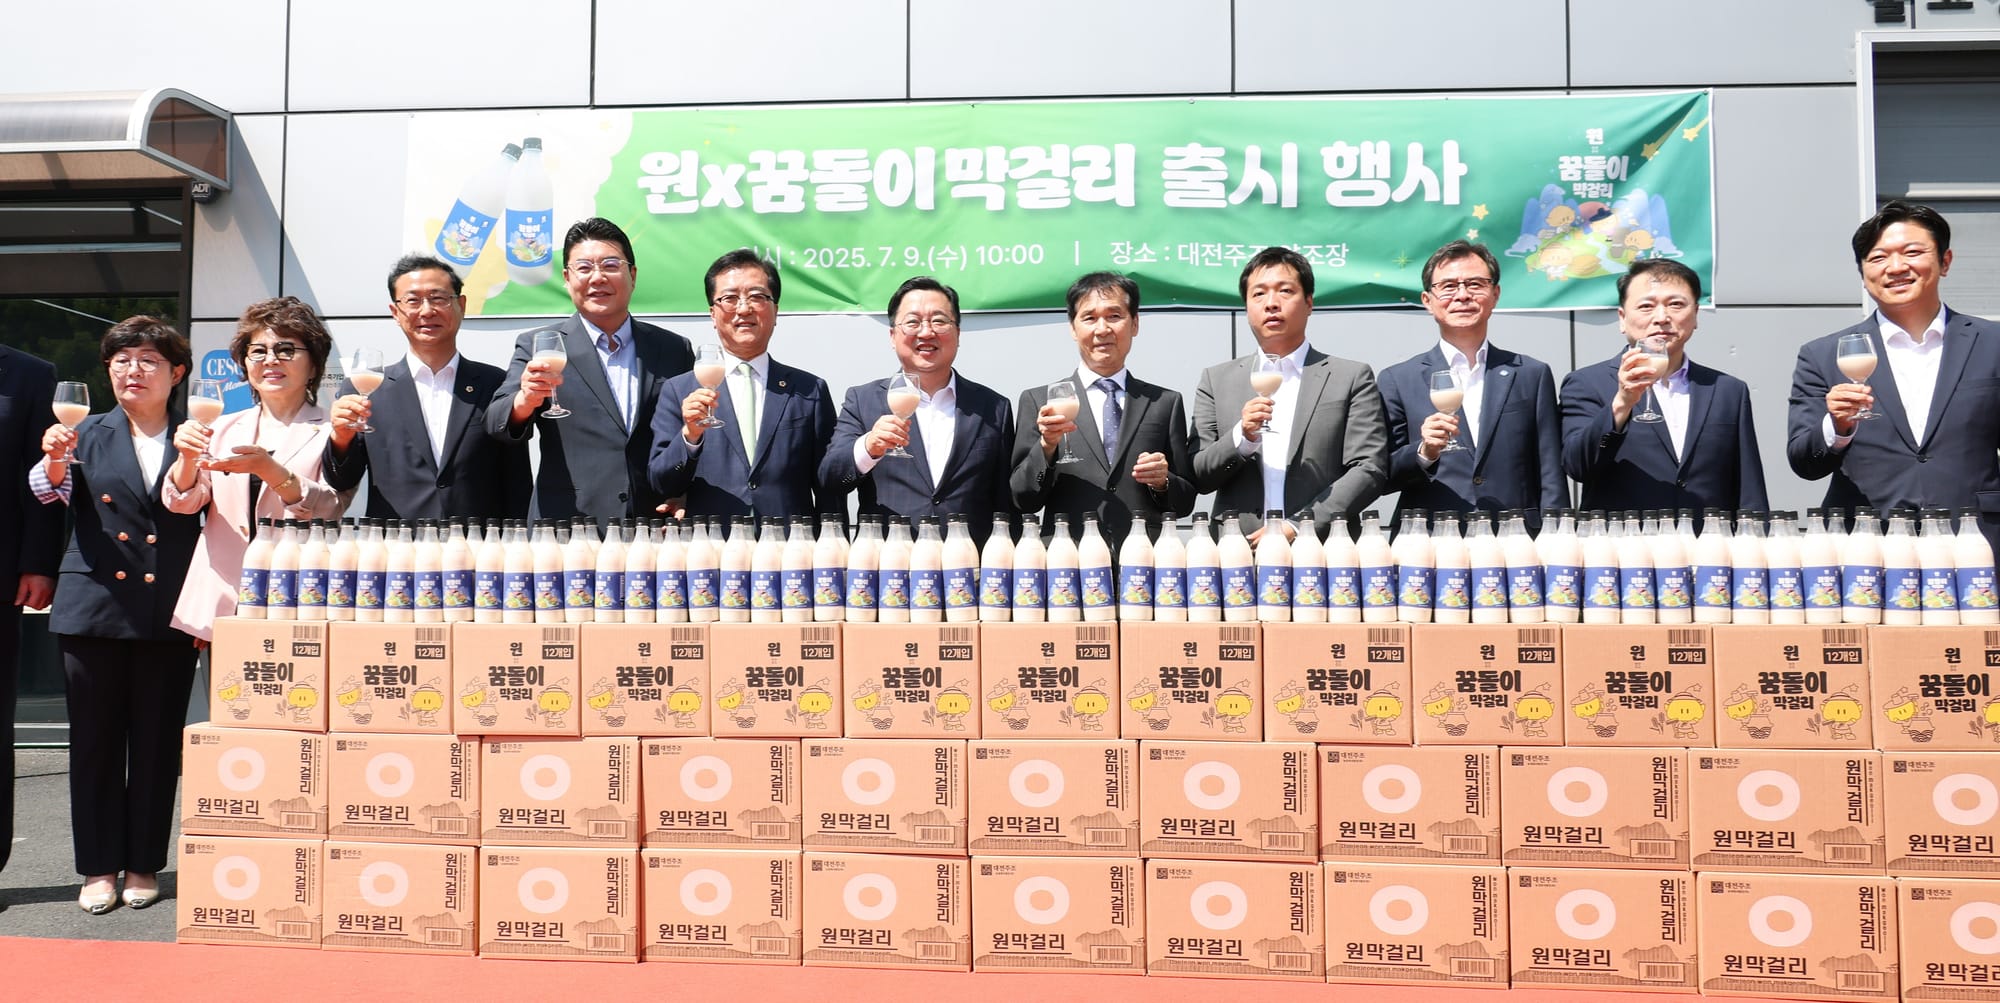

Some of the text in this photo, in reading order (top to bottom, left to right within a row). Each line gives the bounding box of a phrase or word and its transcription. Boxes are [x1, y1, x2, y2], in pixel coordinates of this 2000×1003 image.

[1161, 142, 1298, 208] 출시
[1319, 139, 1468, 207] 행사
[1558, 155, 1629, 181] 꿈돌이
[191, 183, 209, 193] ADT
[1572, 182, 1614, 198] 막걸리
[803, 247, 871, 269] 2025.
[878, 246, 896, 267] 7.
[975, 244, 1045, 266] 10:00
[1109, 242, 1158, 265] 장소
[1281, 243, 1349, 267] 조장
[263, 638, 275, 653] 원
[293, 645, 320, 656] 12개입
[383, 641, 397, 657] 원
[416, 647, 444, 658] 12개입
[509, 641, 523, 657] 원
[544, 647, 572, 658] 12개입
[637, 641, 652, 657] 원
[673, 647, 701, 658] 12개입
[767, 642, 781, 658] 원
[803, 647, 832, 658] 12개입
[904, 642, 919, 658] 원
[941, 647, 970, 659] 12개입
[1040, 641, 1056, 658] 원
[1078, 647, 1108, 658] 12개입
[1182, 641, 1198, 658] 원
[1221, 648, 1252, 659] 12개입
[1330, 643, 1346, 660] 원
[1370, 649, 1402, 661] 12개입
[1479, 644, 1496, 661] 원
[1629, 644, 1646, 662] 원
[1783, 644, 1800, 662] 원
[1520, 650, 1552, 662] 12개입
[1671, 651, 1703, 663] 12개입
[1825, 650, 1859, 663] 12개입
[1944, 647, 1962, 664] 원
[242, 660, 294, 683] 꿈돌이
[363, 664, 418, 686] 꿈돌이
[487, 665, 545, 687] 꿈돌이
[615, 665, 674, 688] 꿈돌이
[745, 665, 804, 688] 꿈돌이
[881, 666, 942, 689] 꿈돌이
[1017, 665, 1080, 689] 꿈돌이
[1158, 666, 1223, 689] 꿈돌이
[1305, 668, 1371, 692] 꿈돌이
[1455, 669, 1522, 693] 꿈돌이
[252, 682, 283, 696] 막걸리
[1604, 670, 1672, 694] 꿈돌이
[1757, 670, 1828, 695] 꿈돌이
[1919, 674, 1990, 697] 꿈돌이
[374, 686, 406, 700] 막걸리
[499, 687, 533, 701] 막걸리
[627, 688, 662, 702] 막걸리
[757, 688, 793, 702] 막걸리
[894, 689, 930, 704] 막걸리
[1030, 689, 1067, 703] 막걸리
[1171, 689, 1209, 704] 막걸리
[1319, 692, 1358, 707] 막걸리
[1469, 694, 1509, 709] 막걸리
[1618, 695, 1659, 710] 막걸리
[1772, 695, 1815, 711] 막걸리
[1934, 698, 1977, 714] 막걸리
[299, 738, 313, 795] 원막걸리
[450, 742, 462, 799] 원막걸리
[607, 744, 622, 802] 원막걸리
[769, 745, 784, 804] 원막걸리
[934, 747, 949, 807] 원막걸리
[1104, 748, 1120, 809] 원막걸리
[1282, 751, 1298, 813] 원막걸리
[1464, 753, 1480, 816] 원막걸리
[1651, 756, 1669, 819] 원막걸리
[1845, 759, 1863, 824] 원막걸리
[197, 797, 259, 816] 원막걸리
[345, 804, 409, 822] 원막걸리
[498, 807, 565, 825] 원막걸리
[659, 810, 727, 828] 원막걸리
[820, 812, 890, 831] 원막걸리
[987, 815, 1060, 834] 원막걸리
[1160, 817, 1235, 837] 원막걸리
[1338, 821, 1416, 841] 원막걸리
[1523, 825, 1603, 845] 원막걸리
[1713, 829, 1795, 849] 원막걸리
[1908, 834, 1994, 854] 원막걸리
[295, 847, 308, 904] 원막걸리
[444, 853, 458, 910] 원막걸리
[606, 857, 620, 915] 원막걸리
[769, 859, 784, 919] 원막걸리
[936, 863, 951, 924] 원막걸리
[1109, 865, 1125, 927] 원막걸리
[1289, 871, 1305, 933] 원막걸리
[1471, 875, 1488, 938] 원막걸리
[1659, 878, 1677, 943] 원막걸리
[193, 907, 255, 926] 원막걸리
[337, 913, 403, 932] 원막걸리
[1858, 886, 1876, 951] 원막걸리
[496, 920, 564, 939] 원막걸리
[658, 923, 727, 942] 원막걸리
[820, 927, 892, 947] 원막걸리
[992, 932, 1065, 951] 원막걸리
[1167, 937, 1242, 957] 원막걸리
[1345, 942, 1424, 963] 원막걸리
[1531, 947, 1611, 967] 원막걸리
[1723, 954, 1807, 976] 원막걸리
